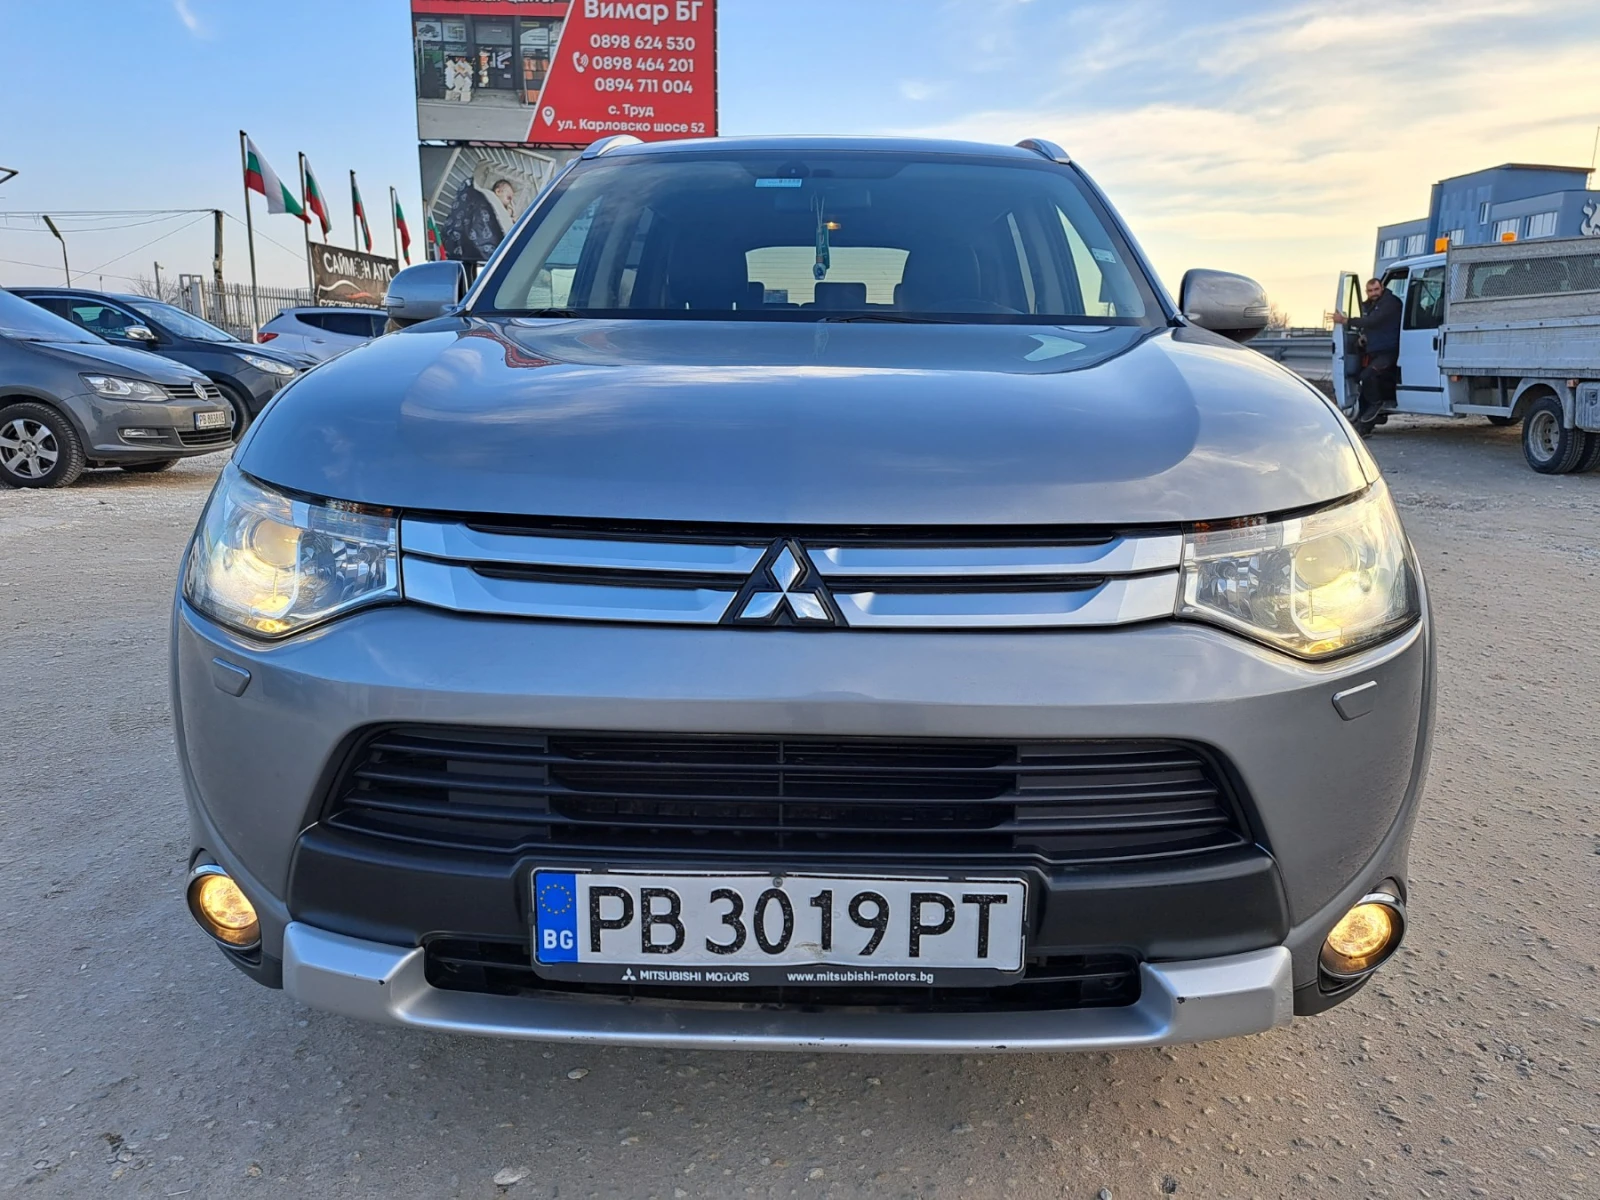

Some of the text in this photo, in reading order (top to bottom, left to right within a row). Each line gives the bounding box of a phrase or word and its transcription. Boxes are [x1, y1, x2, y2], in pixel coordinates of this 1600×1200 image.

[584, 0, 702, 25] Вимар БГ
[589, 34, 696, 51] 0898 624 530
[592, 55, 695, 72] 0898 464 201
[594, 78, 694, 94] 0894 711 004
[608, 104, 654, 118] с. Труд
[557, 119, 705, 134] ул. Карловско шосе 52
[588, 886, 1008, 959] PB 3019 PT
[543, 930, 574, 950] BG
[639, 970, 701, 982] MITSUBISHI
[787, 971, 934, 983] www.mitsubishi-motors.bg
